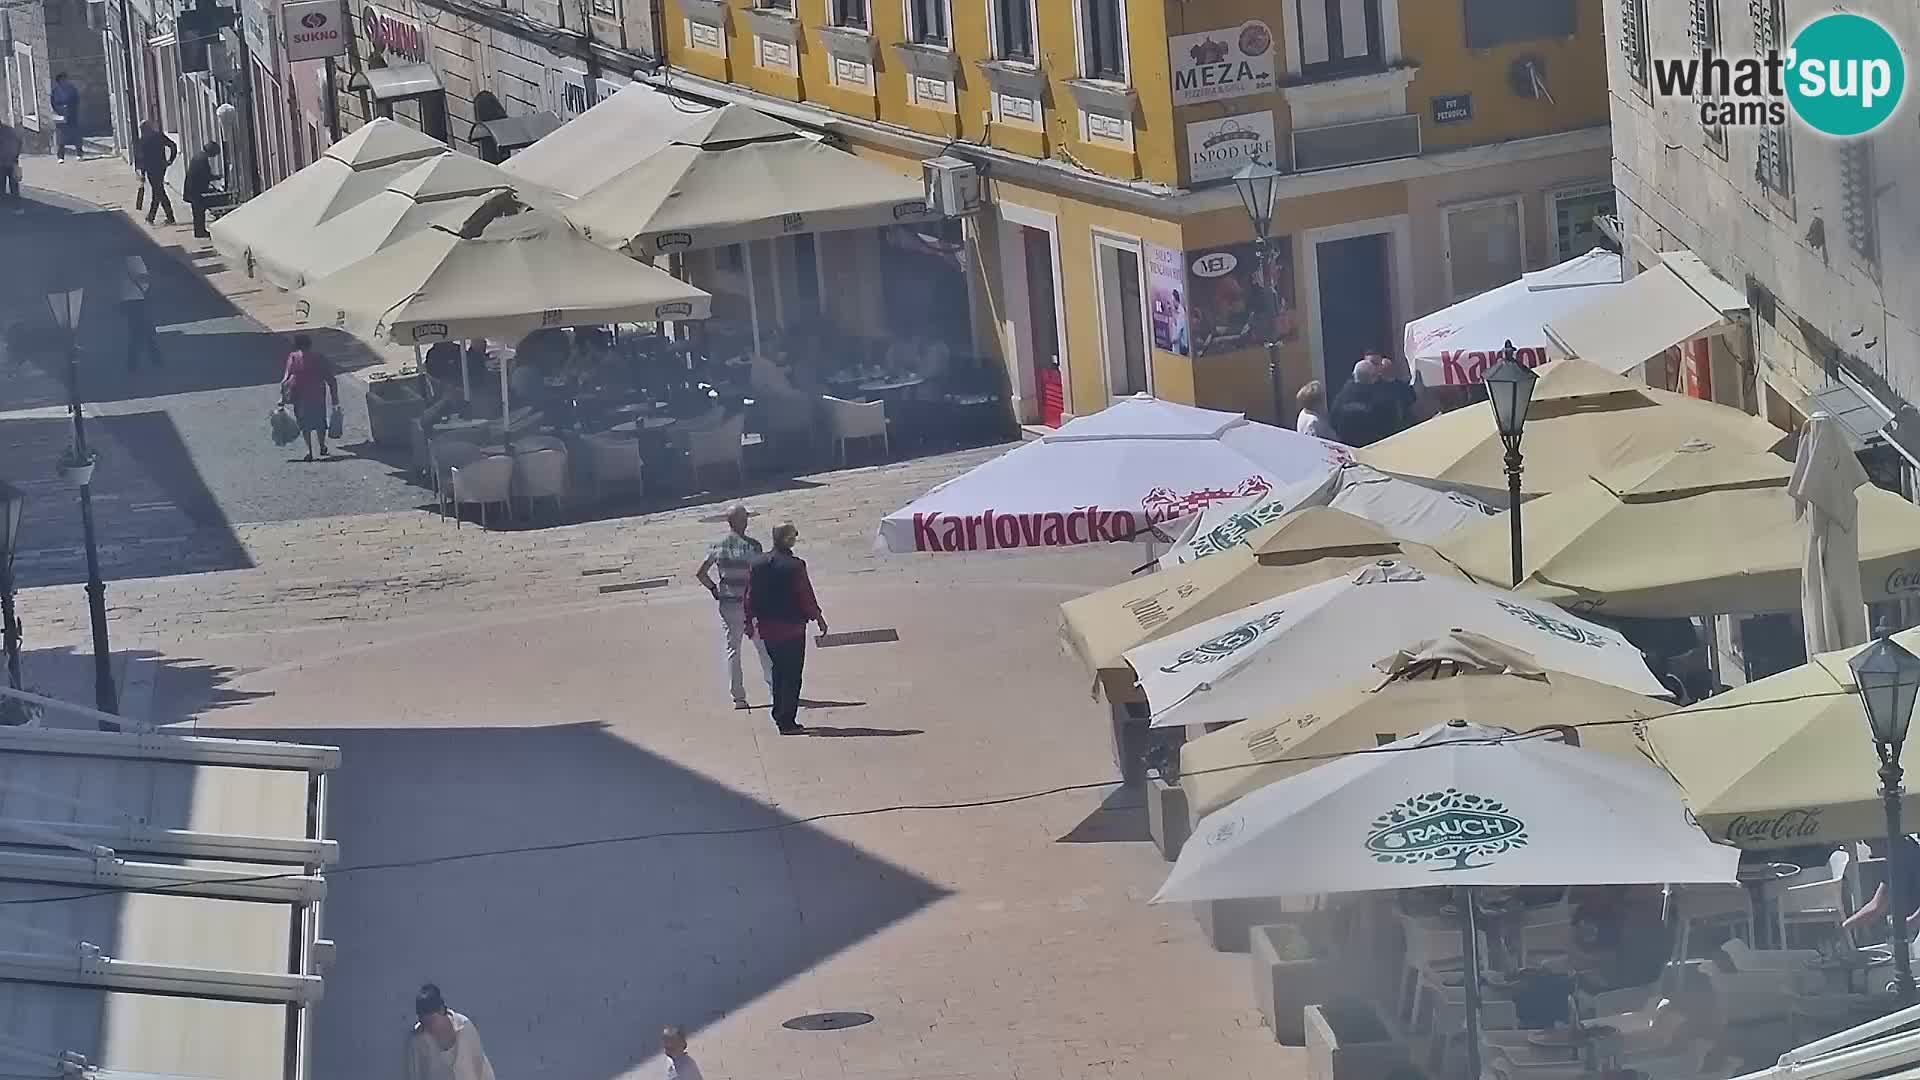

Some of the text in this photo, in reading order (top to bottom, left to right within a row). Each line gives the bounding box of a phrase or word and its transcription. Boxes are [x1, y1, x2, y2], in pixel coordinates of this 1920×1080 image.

[293, 30, 338, 43] SUKNO
[1175, 61, 1254, 91] MEZA
[1193, 145, 1239, 164] ISPOD
[913, 506, 1136, 552] Karlovačko
[1405, 819, 1505, 844] RAUCH
